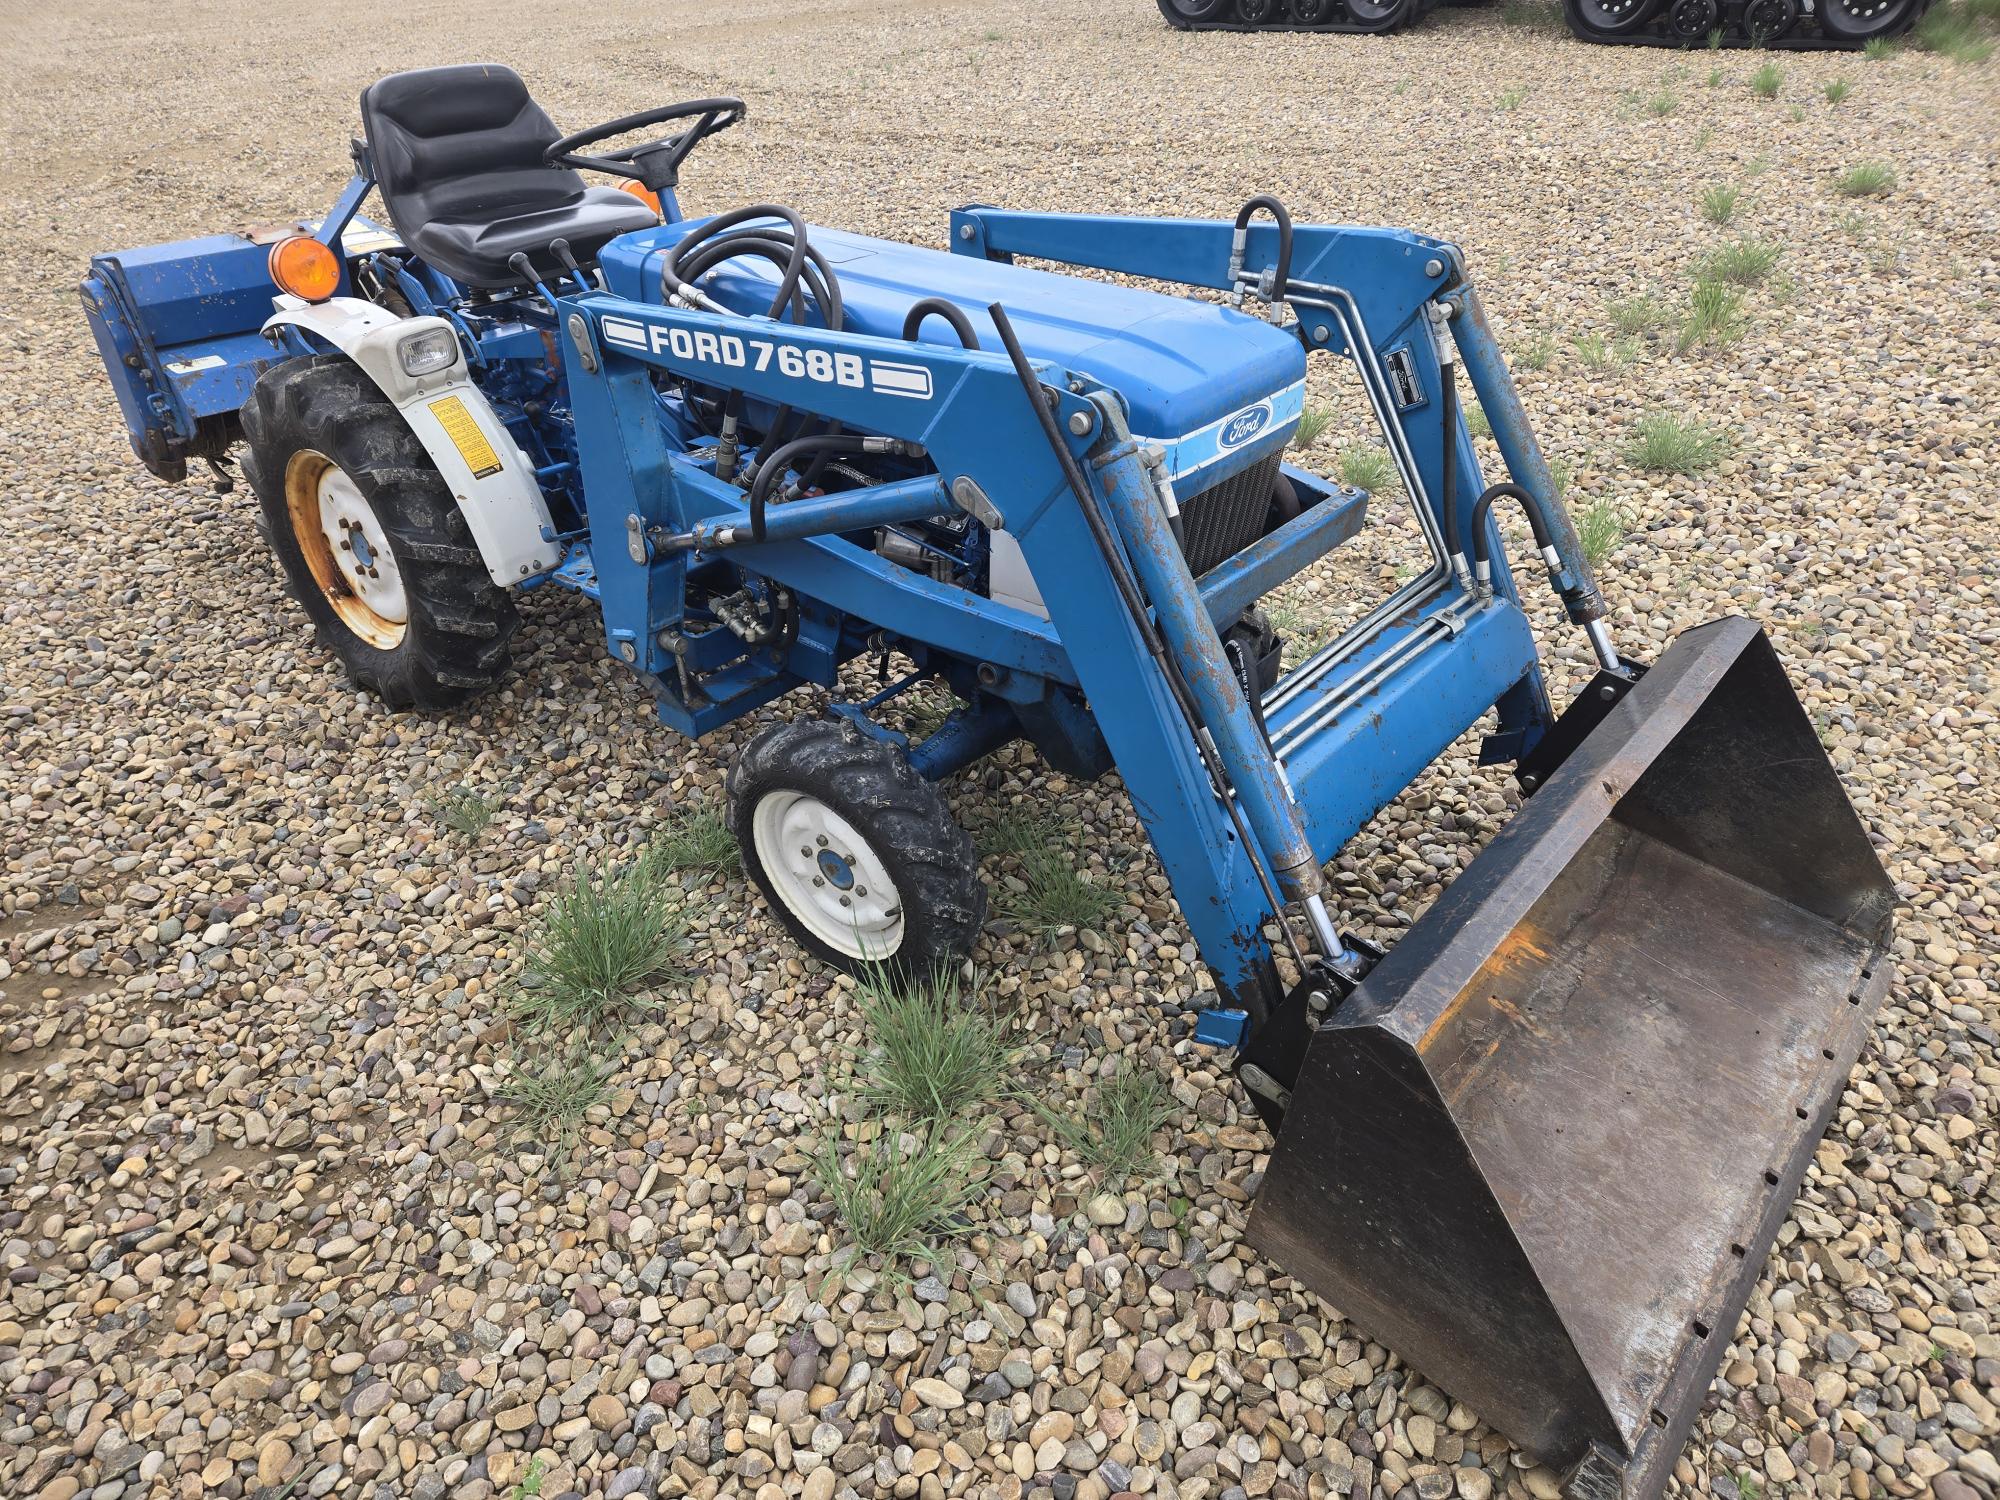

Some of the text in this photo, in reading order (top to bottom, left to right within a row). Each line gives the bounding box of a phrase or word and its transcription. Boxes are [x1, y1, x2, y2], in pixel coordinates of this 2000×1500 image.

[649, 325, 864, 388] FORD 768B
[1397, 369, 1408, 391] Ford
[1229, 411, 1261, 442] Ford
